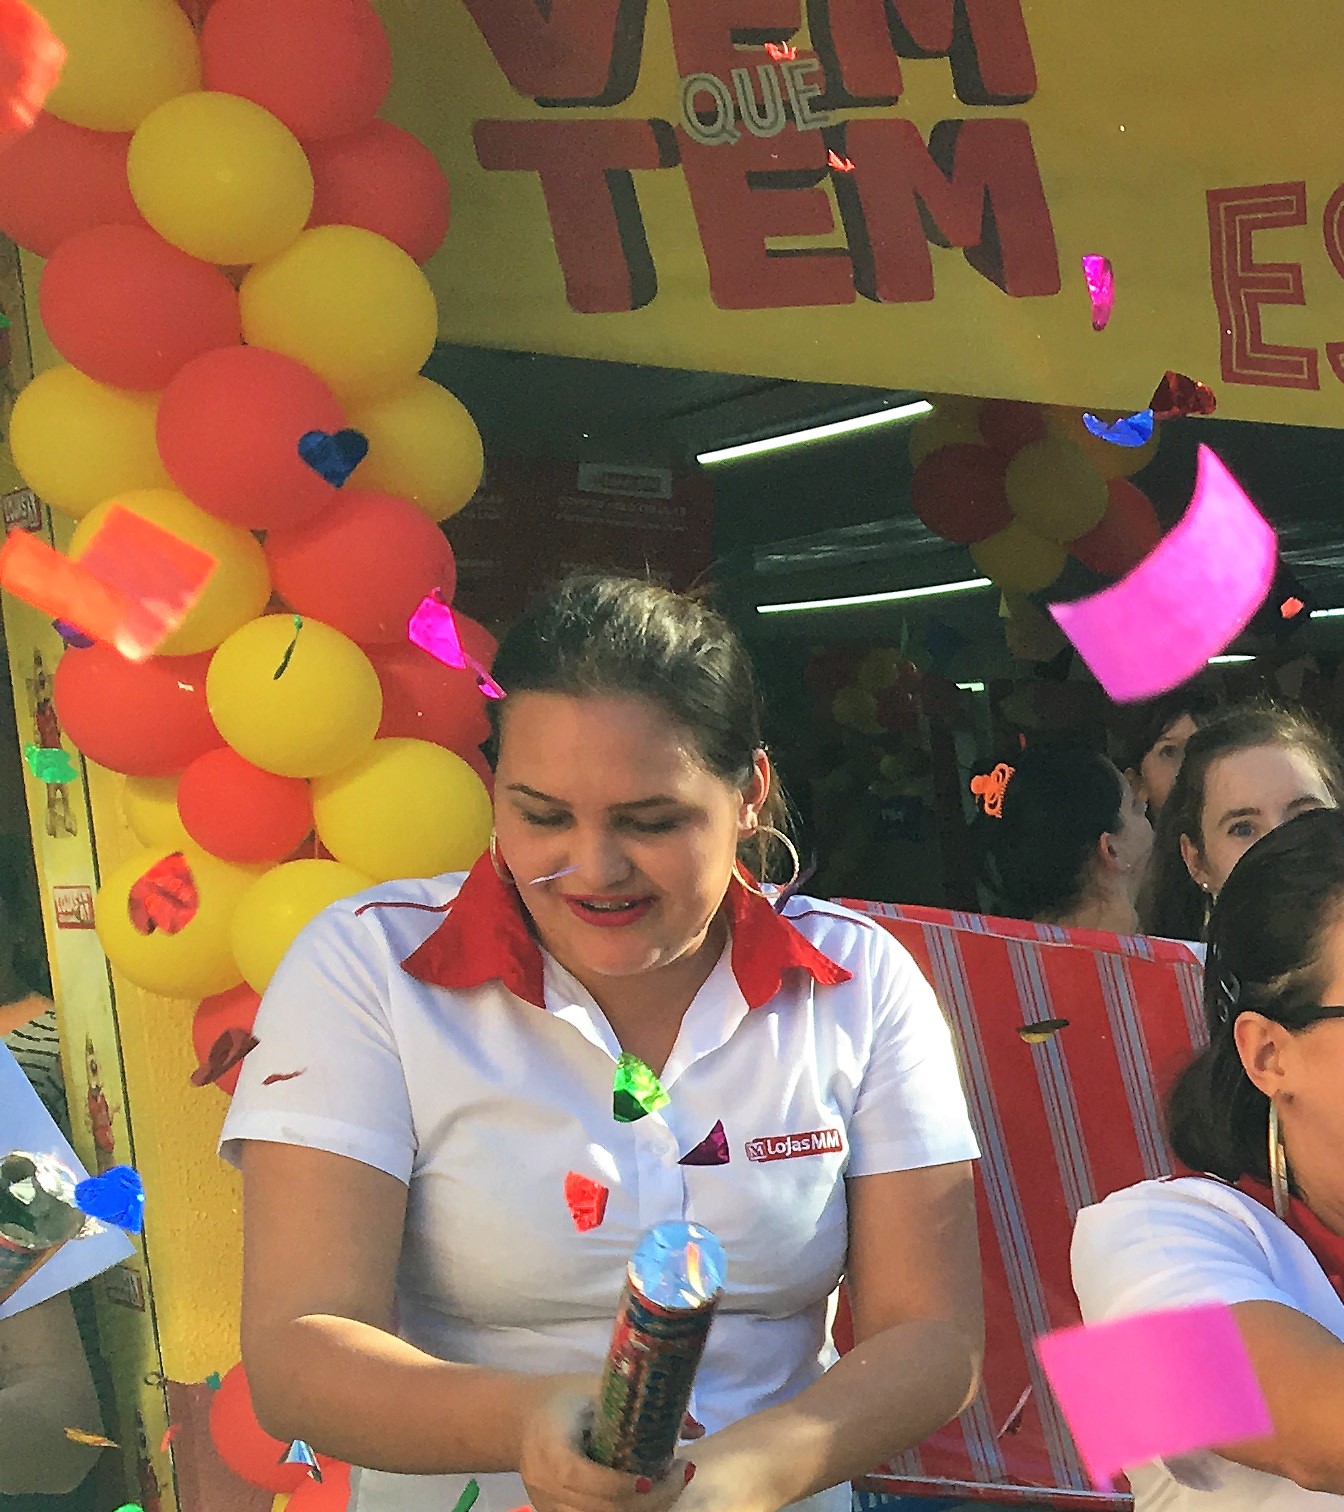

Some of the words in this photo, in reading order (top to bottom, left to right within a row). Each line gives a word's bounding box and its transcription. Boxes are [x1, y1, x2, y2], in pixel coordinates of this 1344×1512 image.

[462, 0, 1038, 108] VEM
[678, 58, 832, 146] QUE
[472, 118, 1061, 314] TEM
